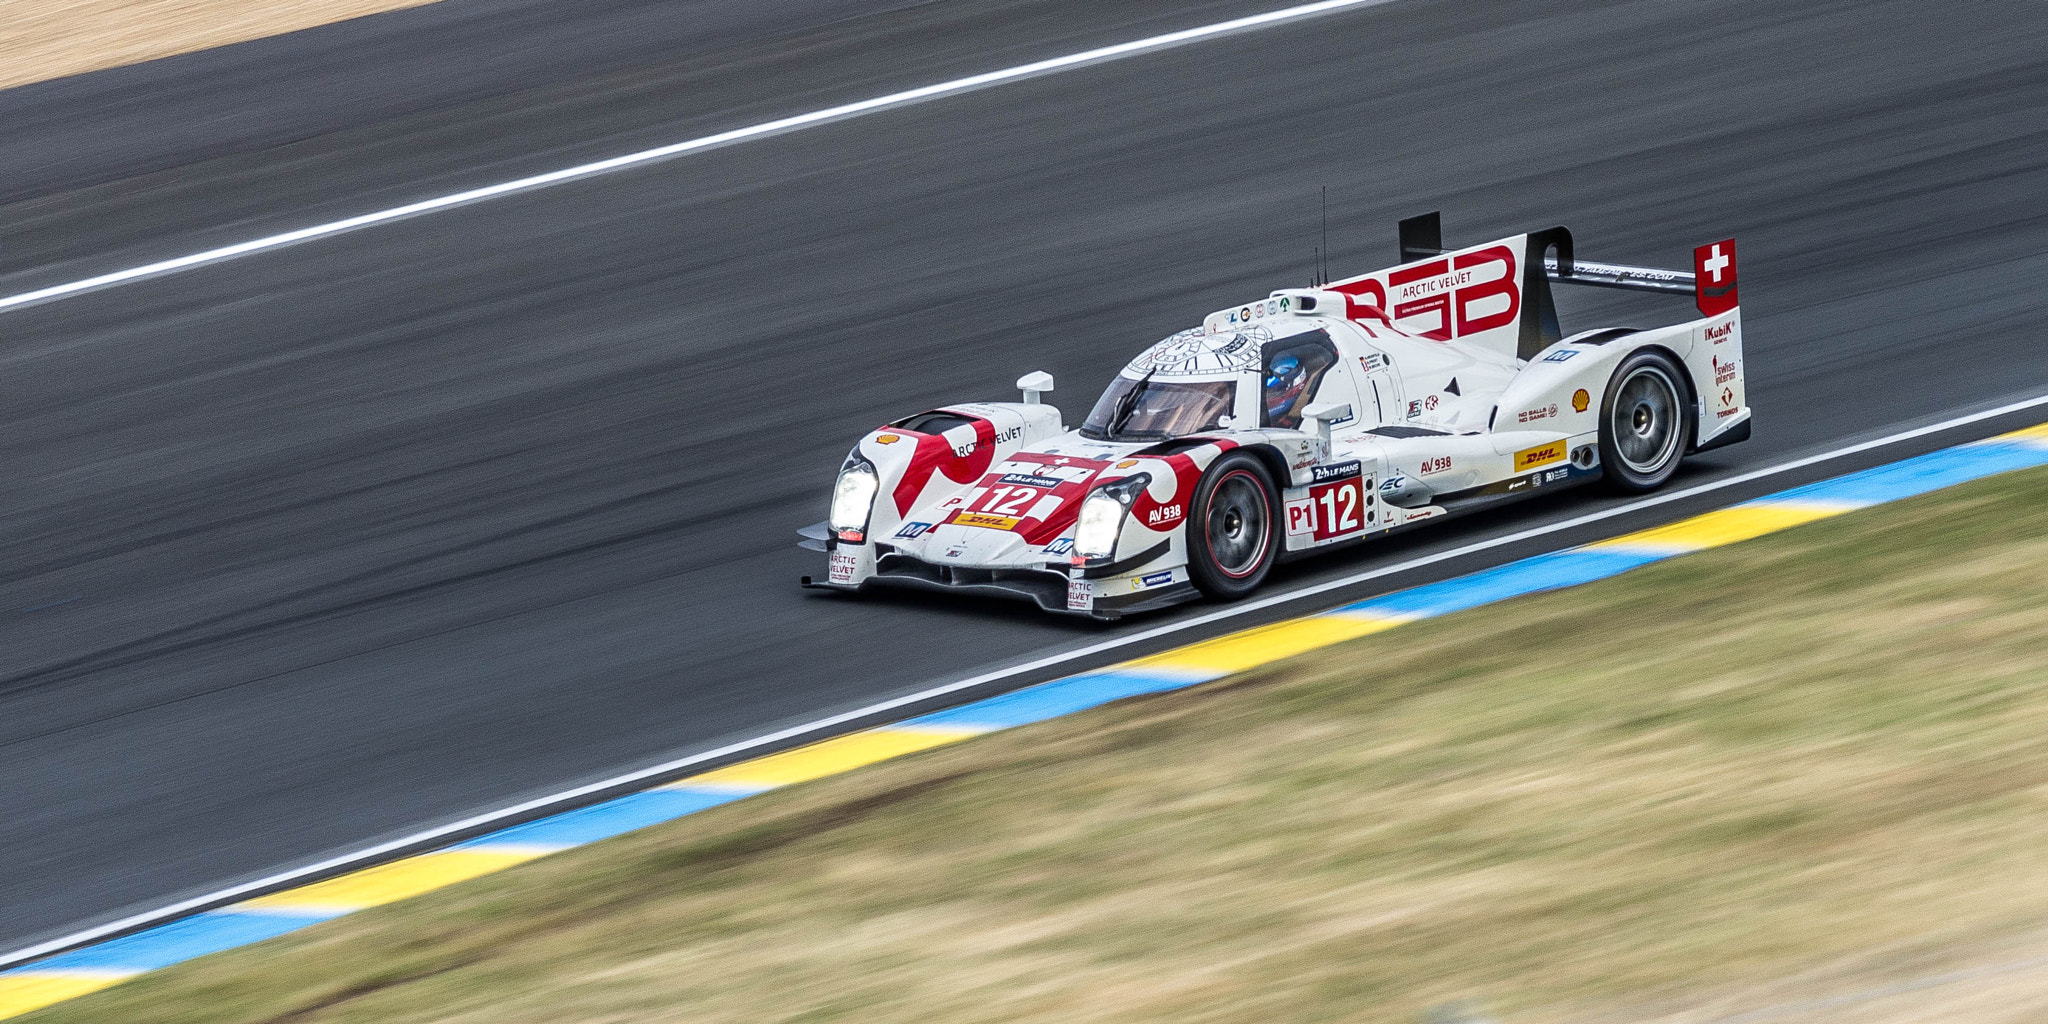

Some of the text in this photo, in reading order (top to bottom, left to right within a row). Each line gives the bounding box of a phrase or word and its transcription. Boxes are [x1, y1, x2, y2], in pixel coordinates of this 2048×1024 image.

[1402, 271, 1472, 299] ARCTIC VELVET
[1528, 407, 1547, 416] BALLS
[1716, 406, 1739, 419] TORNOS
[952, 426, 1022, 459] ARCTIC VELVET
[1420, 457, 1434, 474] AV
[1434, 455, 1452, 471] 938
[1526, 447, 1557, 464] DHL
[1330, 468, 1339, 477] LE
[1338, 463, 1360, 475] MANS
[980, 485, 1038, 516] 12
[1320, 484, 1359, 533] 12
[967, 515, 1005, 526] DHL
[1148, 505, 1163, 523] AV
[1163, 504, 1182, 520] 938
[1289, 503, 1313, 531] P1
